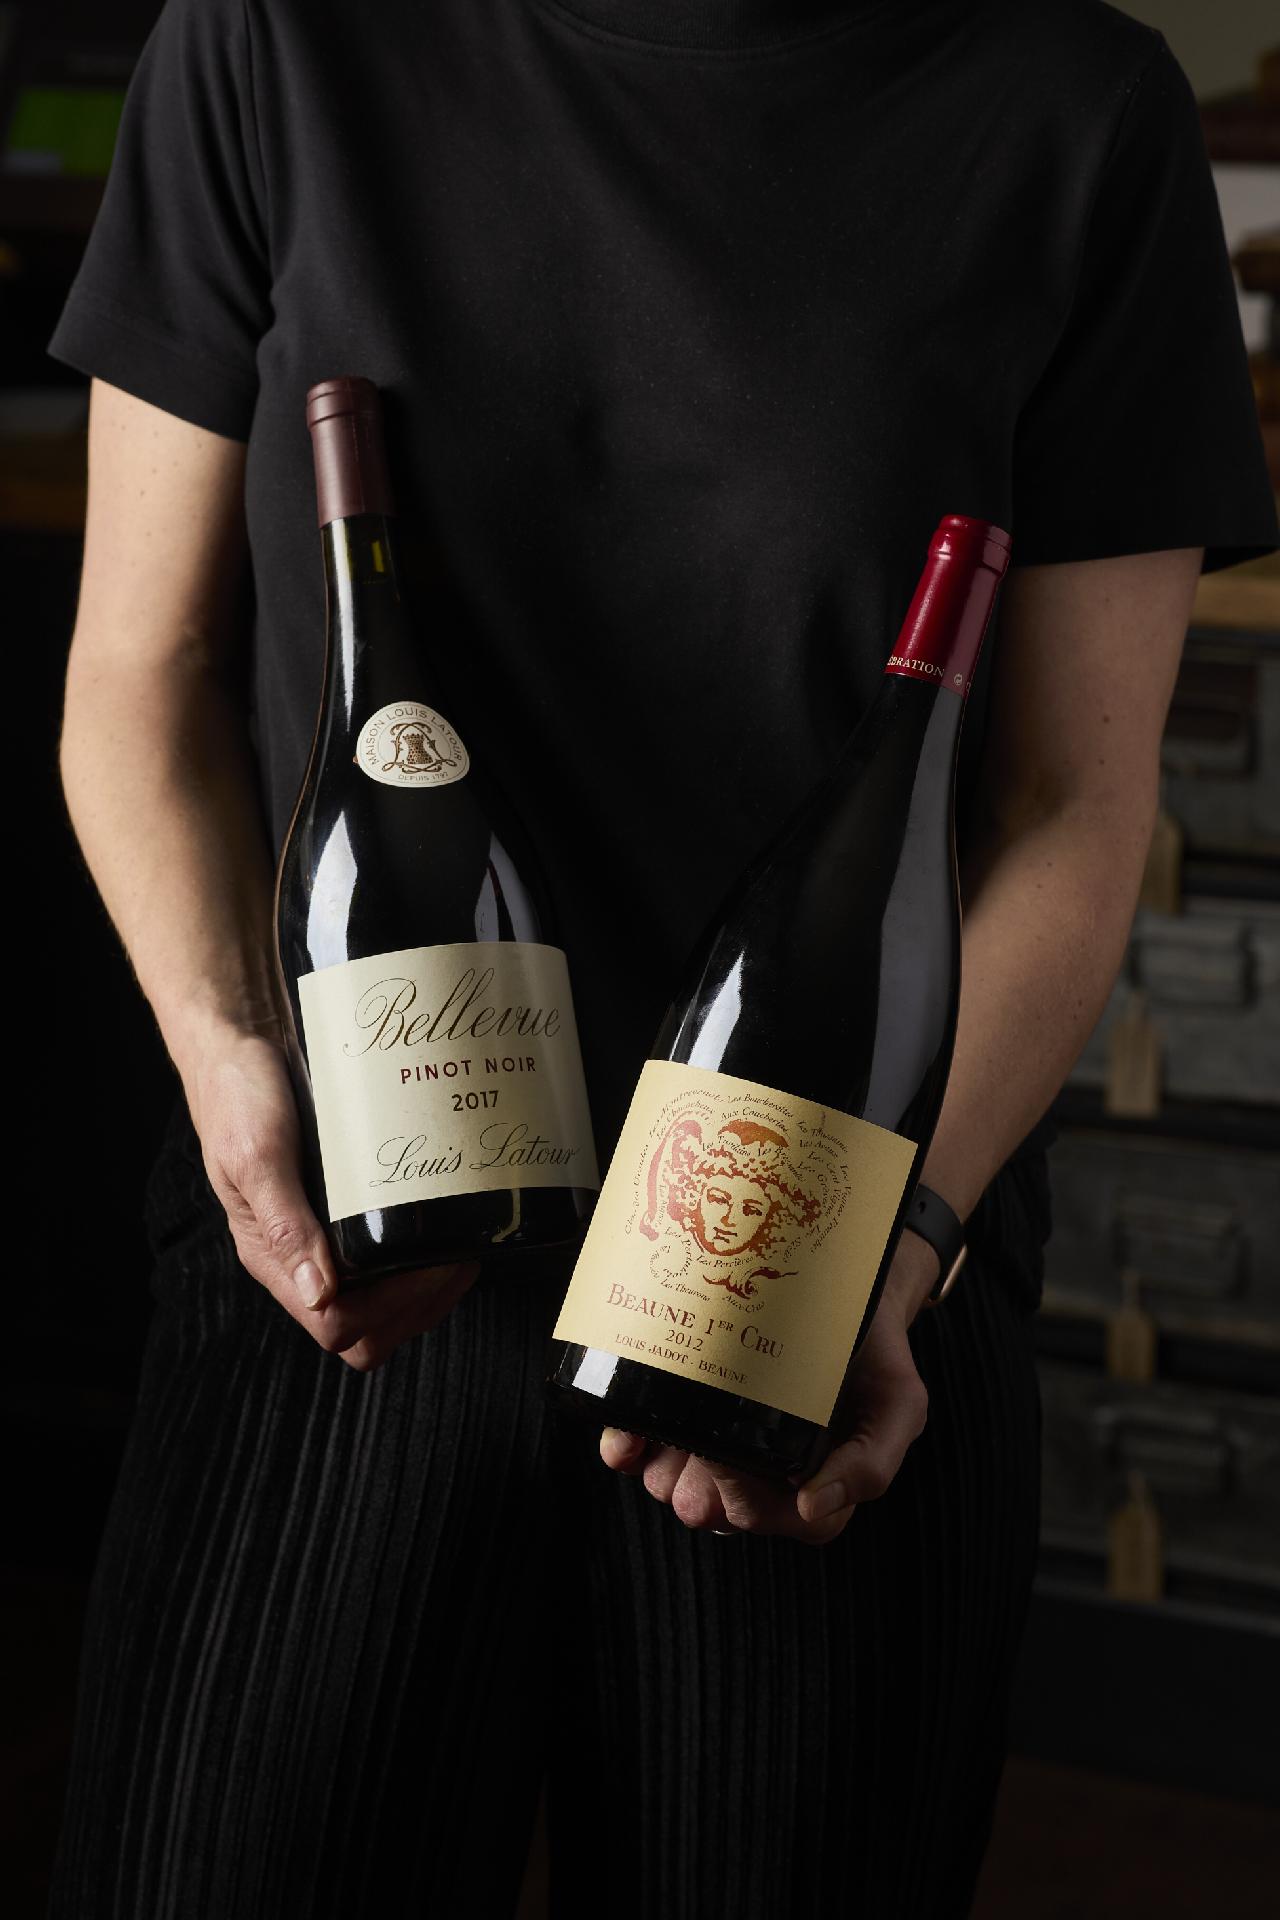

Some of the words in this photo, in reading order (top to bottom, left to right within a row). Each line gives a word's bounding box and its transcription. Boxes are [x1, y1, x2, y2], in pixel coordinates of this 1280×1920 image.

[366, 720, 385, 766] MAISON
[387, 708, 428, 721] LOUIS
[430, 716, 463, 763] LATOUR
[342, 966, 562, 1058] Bellevue
[400, 1059, 473, 1084] PINOT
[485, 1056, 538, 1075] NOIR
[451, 1090, 500, 1112] 2017
[368, 1134, 464, 1188] Louis
[468, 1122, 580, 1171] Latour
[606, 1283, 696, 1329] BEAUNE
[740, 1325, 785, 1359] CRU
[665, 1328, 704, 1352] 2012
[615, 1333, 647, 1350] LOUIS
[648, 1344, 689, 1365] JADOT
[698, 1360, 748, 1384] BEAUNE
